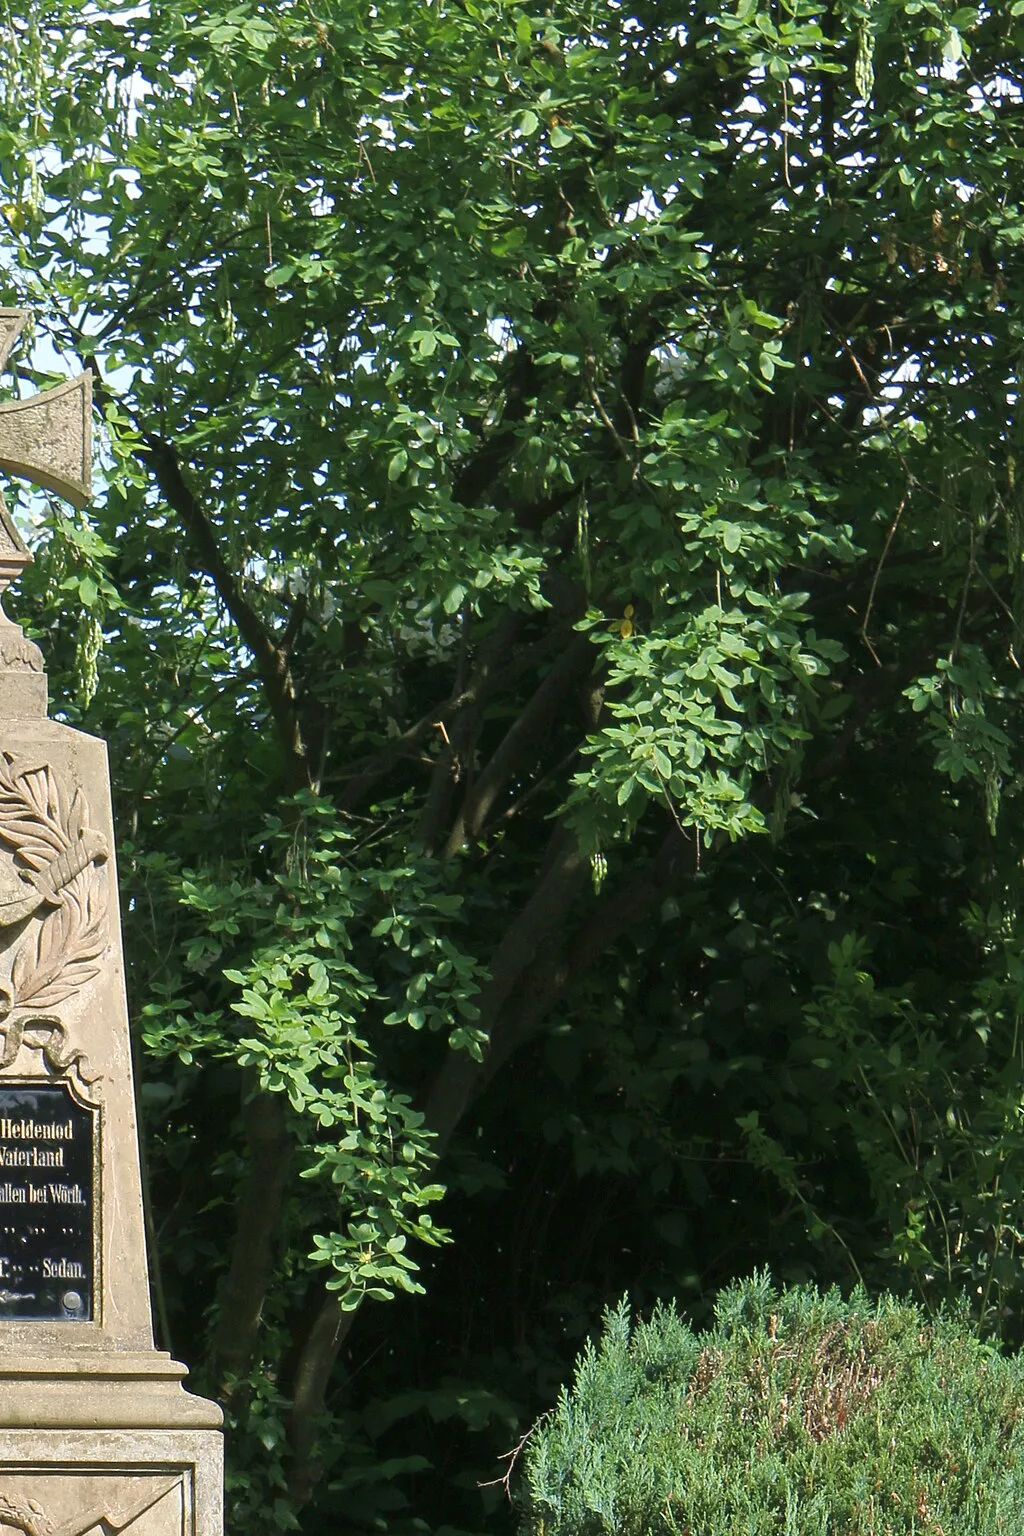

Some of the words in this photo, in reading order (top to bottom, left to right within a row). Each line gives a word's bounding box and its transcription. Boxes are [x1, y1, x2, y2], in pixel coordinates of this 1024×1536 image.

[0, 1119, 73, 1140] Heldentod
[28, 1183, 48, 1203] bei
[49, 1183, 87, 1206] Wörth,
[42, 1257, 87, 1279] Sedan.
